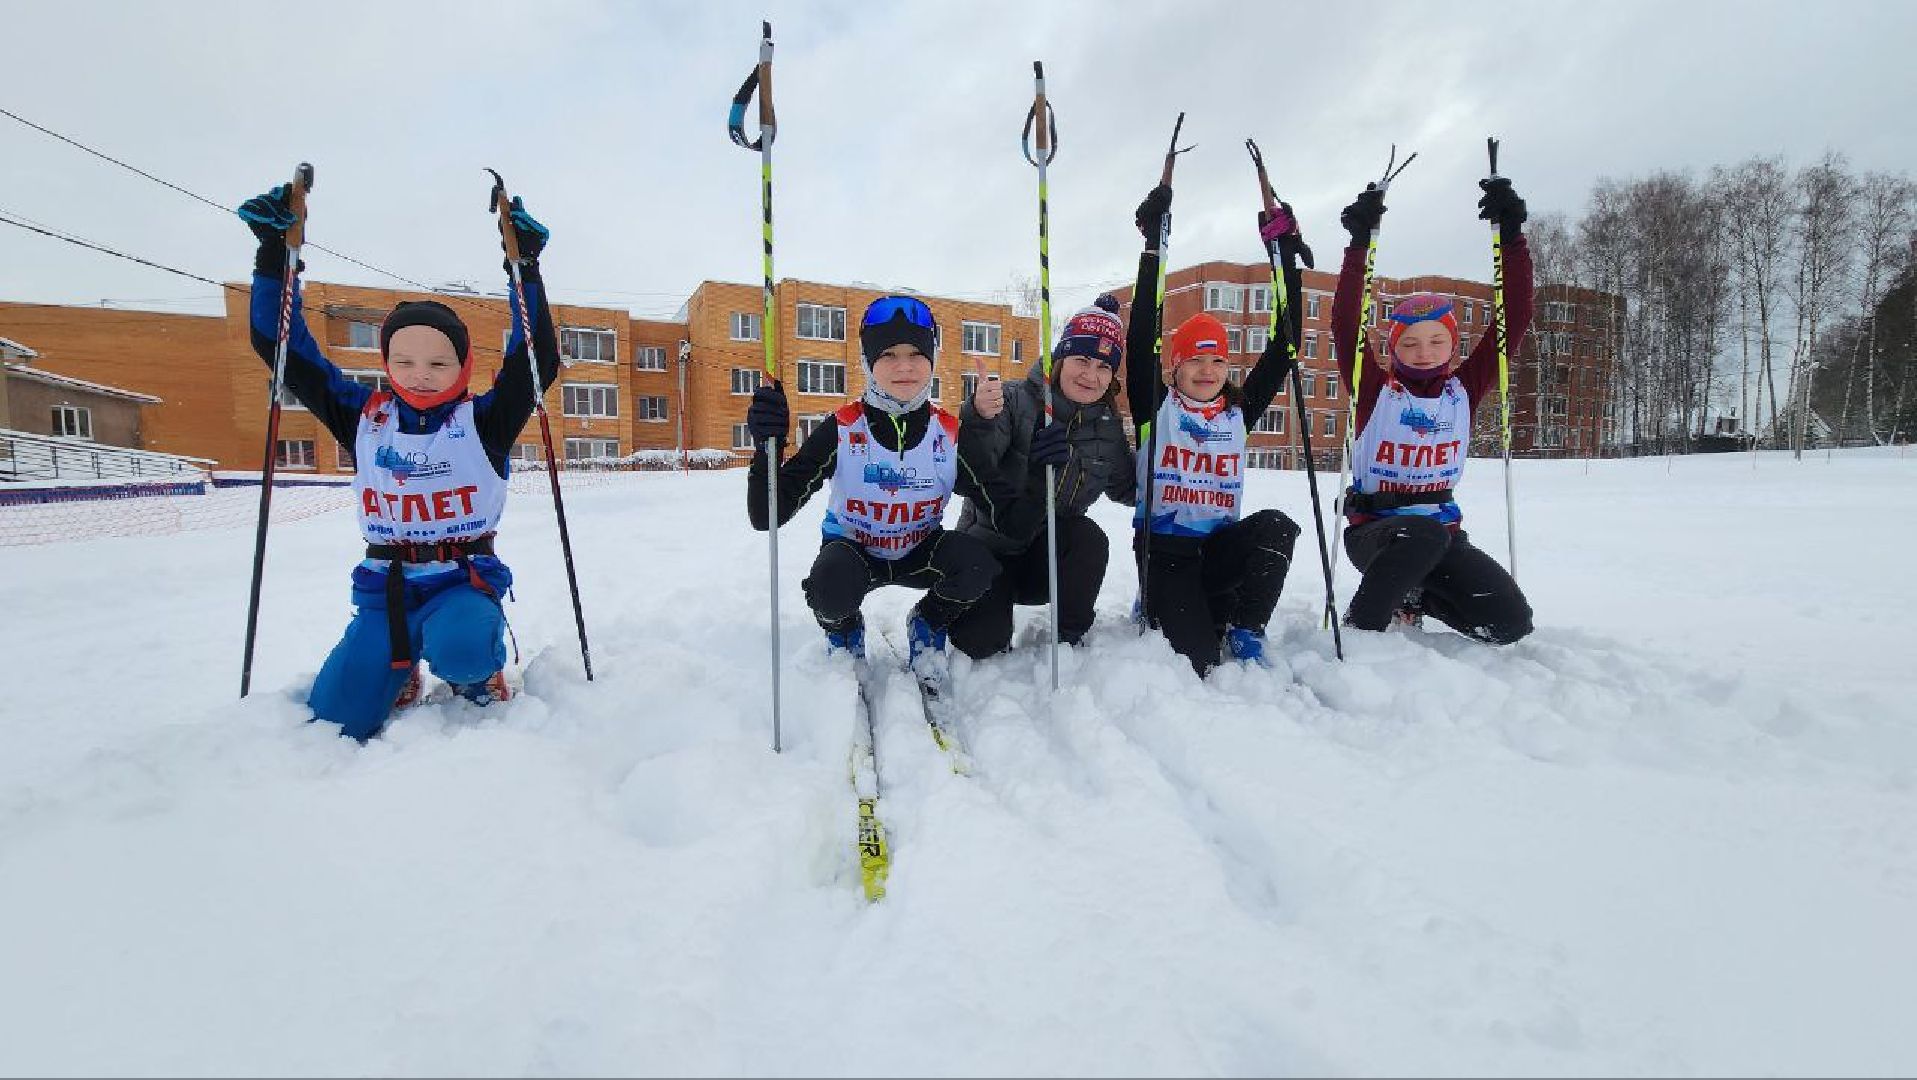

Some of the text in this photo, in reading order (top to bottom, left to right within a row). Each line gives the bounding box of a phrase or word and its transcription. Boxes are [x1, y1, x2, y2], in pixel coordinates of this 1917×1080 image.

[1160, 445, 1241, 477] АТЛЕТ
[1376, 440, 1461, 468] АТЛЕТ
[362, 485, 478, 523] АТЛЕТ
[1162, 485, 1235, 508] ДМИТРОВ
[846, 497, 944, 525] АТЛЕТ
